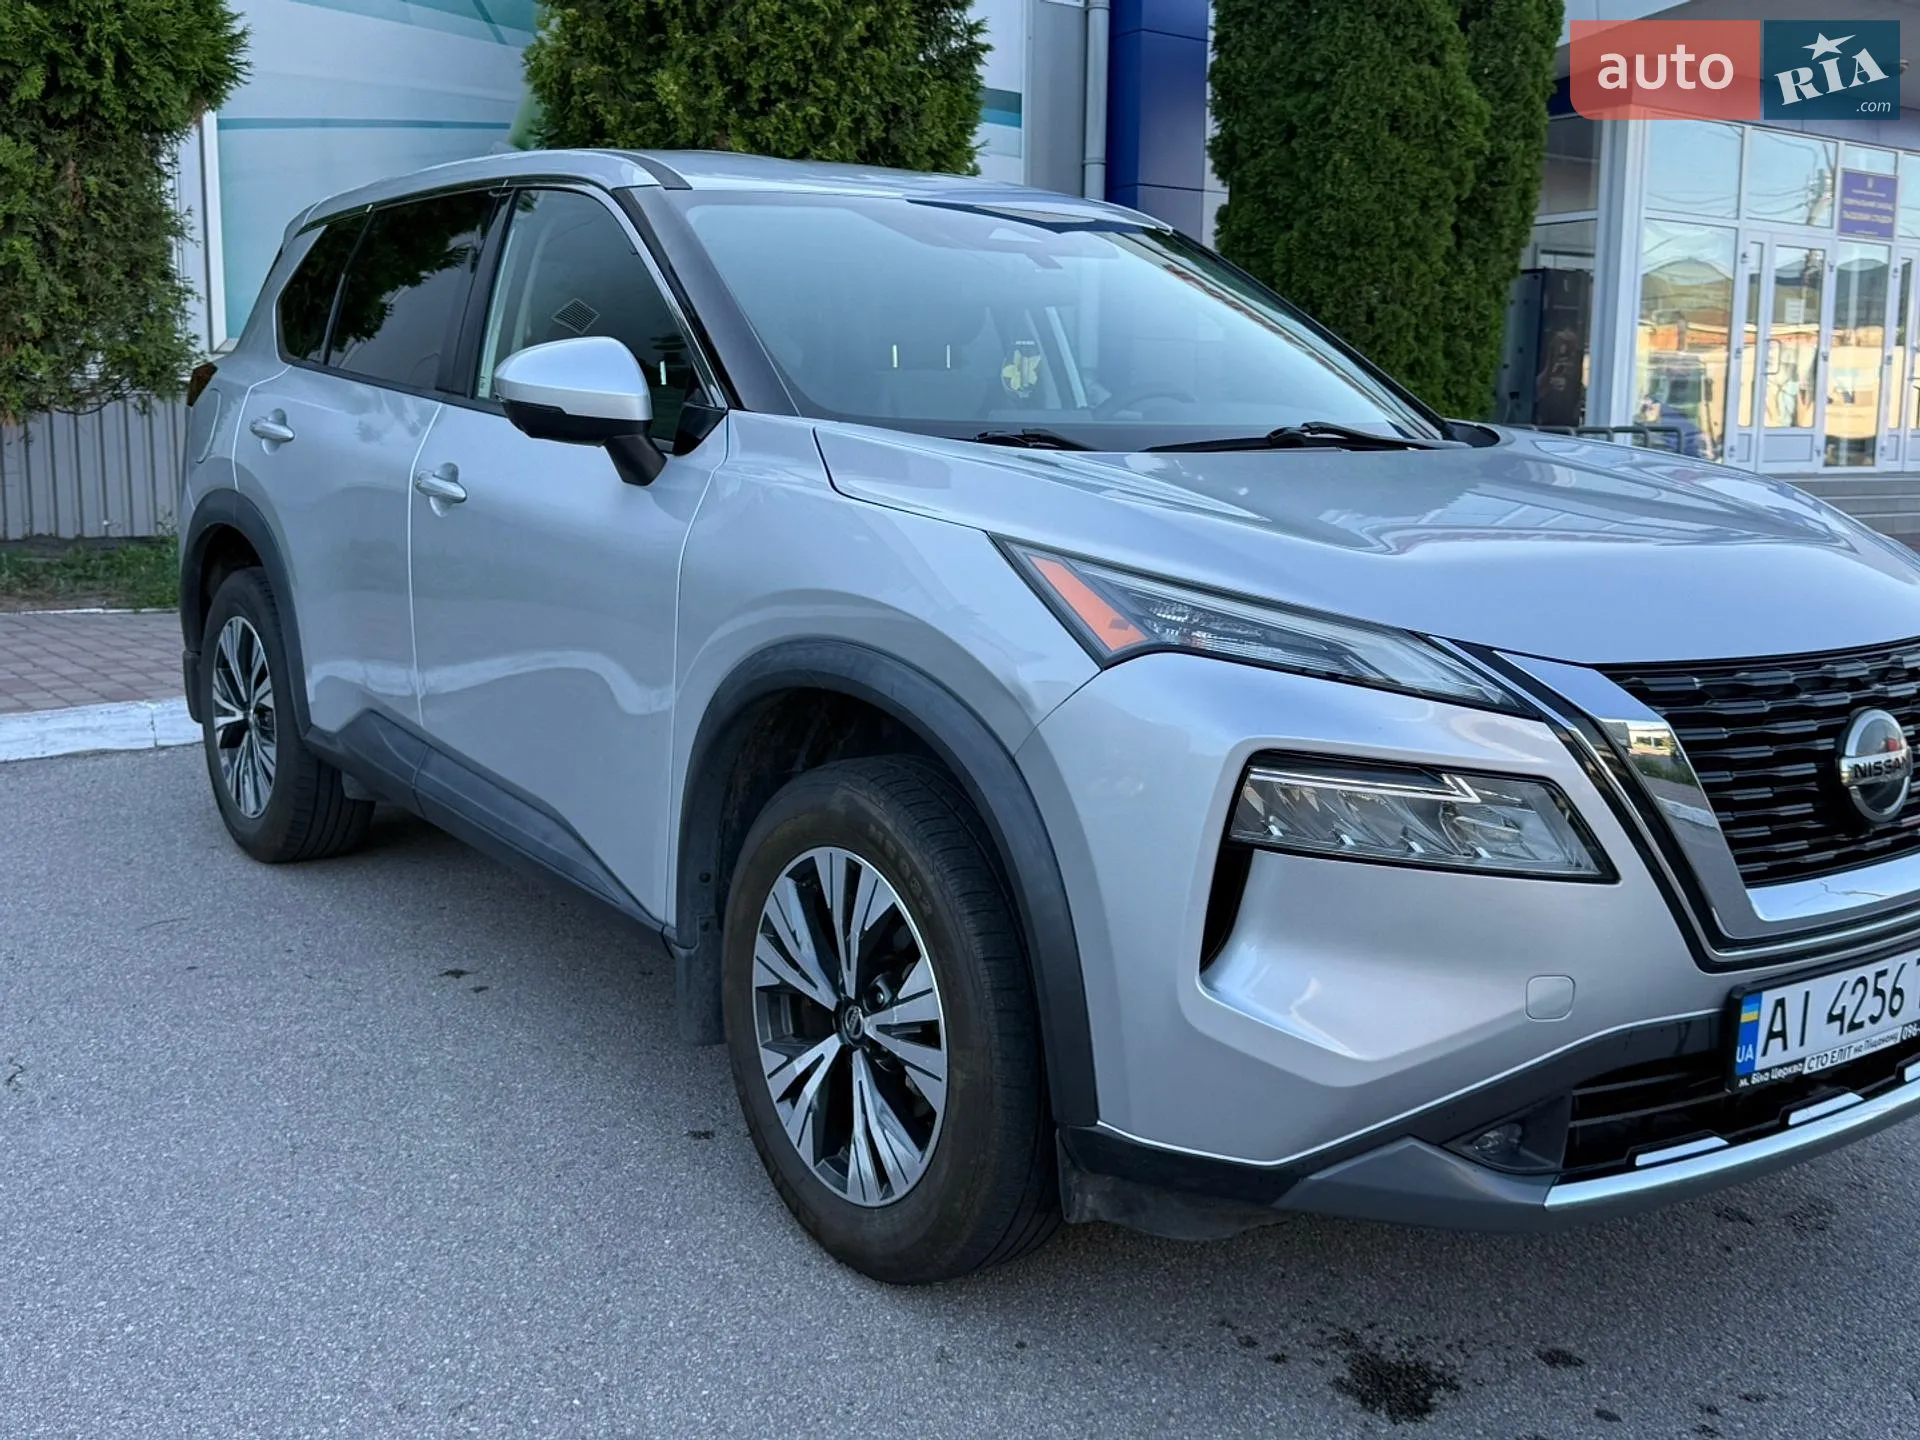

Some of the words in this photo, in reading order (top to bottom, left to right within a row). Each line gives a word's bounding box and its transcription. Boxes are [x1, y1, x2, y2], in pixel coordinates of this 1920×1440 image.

[1853, 756, 1907, 779] NISSAN
[1761, 990, 1810, 1057] AI
[1826, 963, 1907, 1036] 4256
[1736, 1044, 1754, 1063] UA
[1807, 1053, 1828, 1070] СТО
